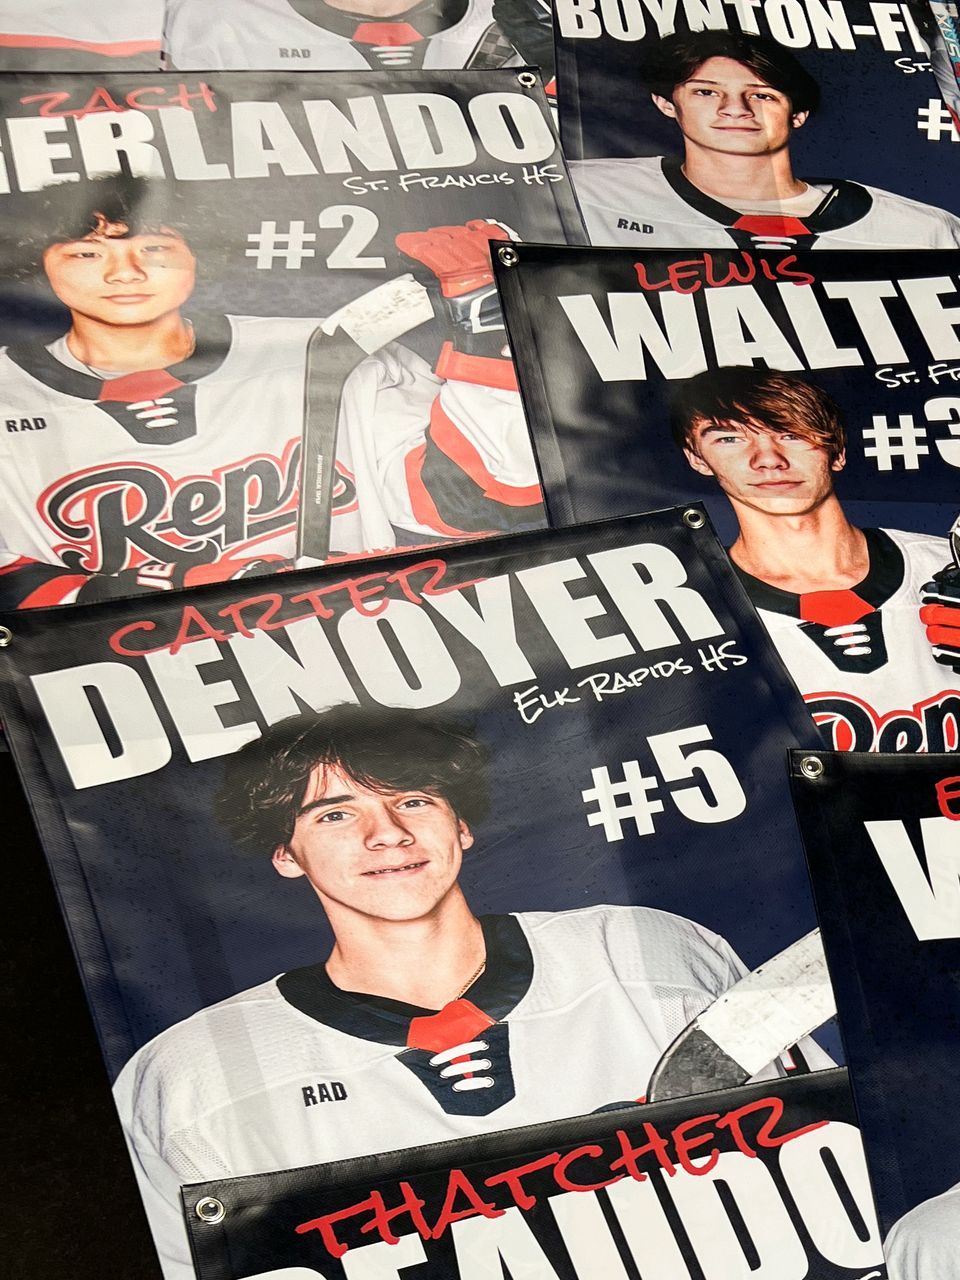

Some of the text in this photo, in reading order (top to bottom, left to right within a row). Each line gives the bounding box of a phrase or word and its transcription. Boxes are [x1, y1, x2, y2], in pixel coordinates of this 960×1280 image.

[279, 47, 311, 60] RAD
[20, 82, 217, 121] ZACH
[0, 92, 556, 194] ERLANDO
[398, 171, 515, 193] FRANCIS
[522, 164, 564, 186] HS
[245, 204, 387, 270] #2
[617, 217, 654, 236] RAD
[634, 252, 814, 294] LEWIS
[5, 416, 47, 434] RAD
[109, 558, 487, 660] CARTER
[28, 541, 725, 791] DENOYER
[513, 640, 748, 725] ELK RAPIDS HS
[580, 724, 748, 843] #5
[302, 1081, 348, 1107] RAD
[295, 1096, 830, 1258] THATCHER
